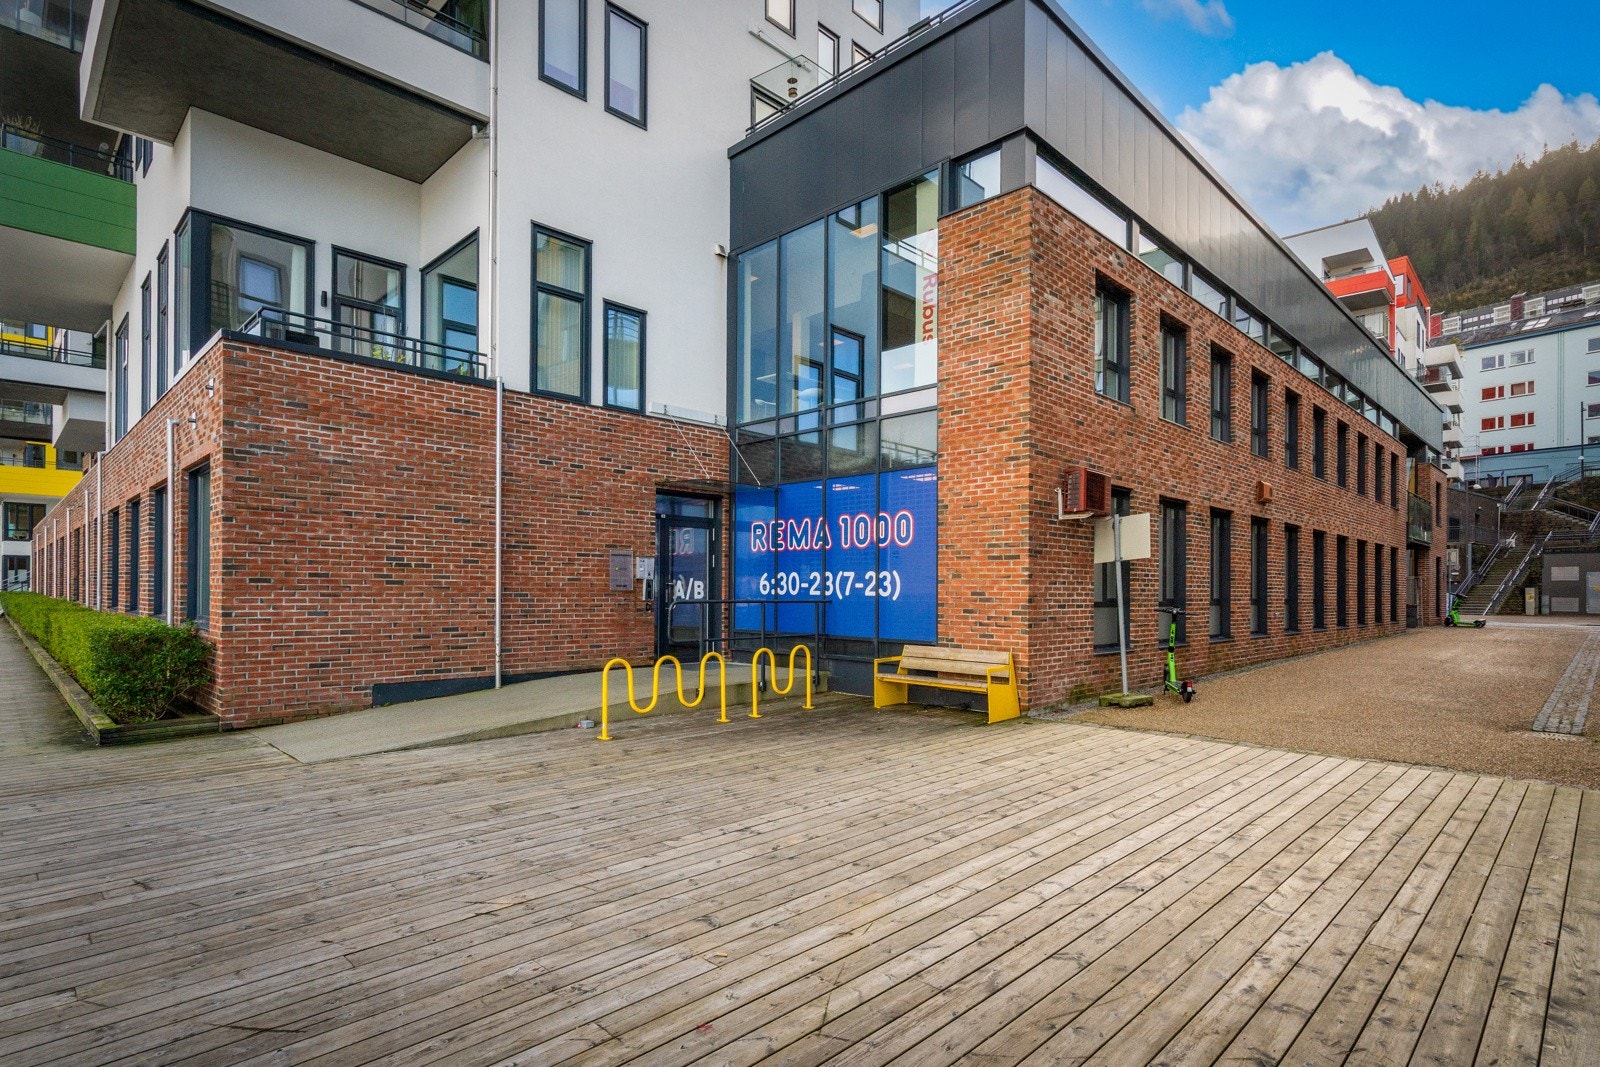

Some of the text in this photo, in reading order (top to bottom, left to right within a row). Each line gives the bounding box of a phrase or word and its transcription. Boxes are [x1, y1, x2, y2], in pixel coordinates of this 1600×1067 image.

[922, 272, 938, 342] Rubus
[751, 510, 915, 552] REMA 1000
[674, 577, 705, 600] A/B
[759, 570, 901, 601] 6:30-23(7-23)
